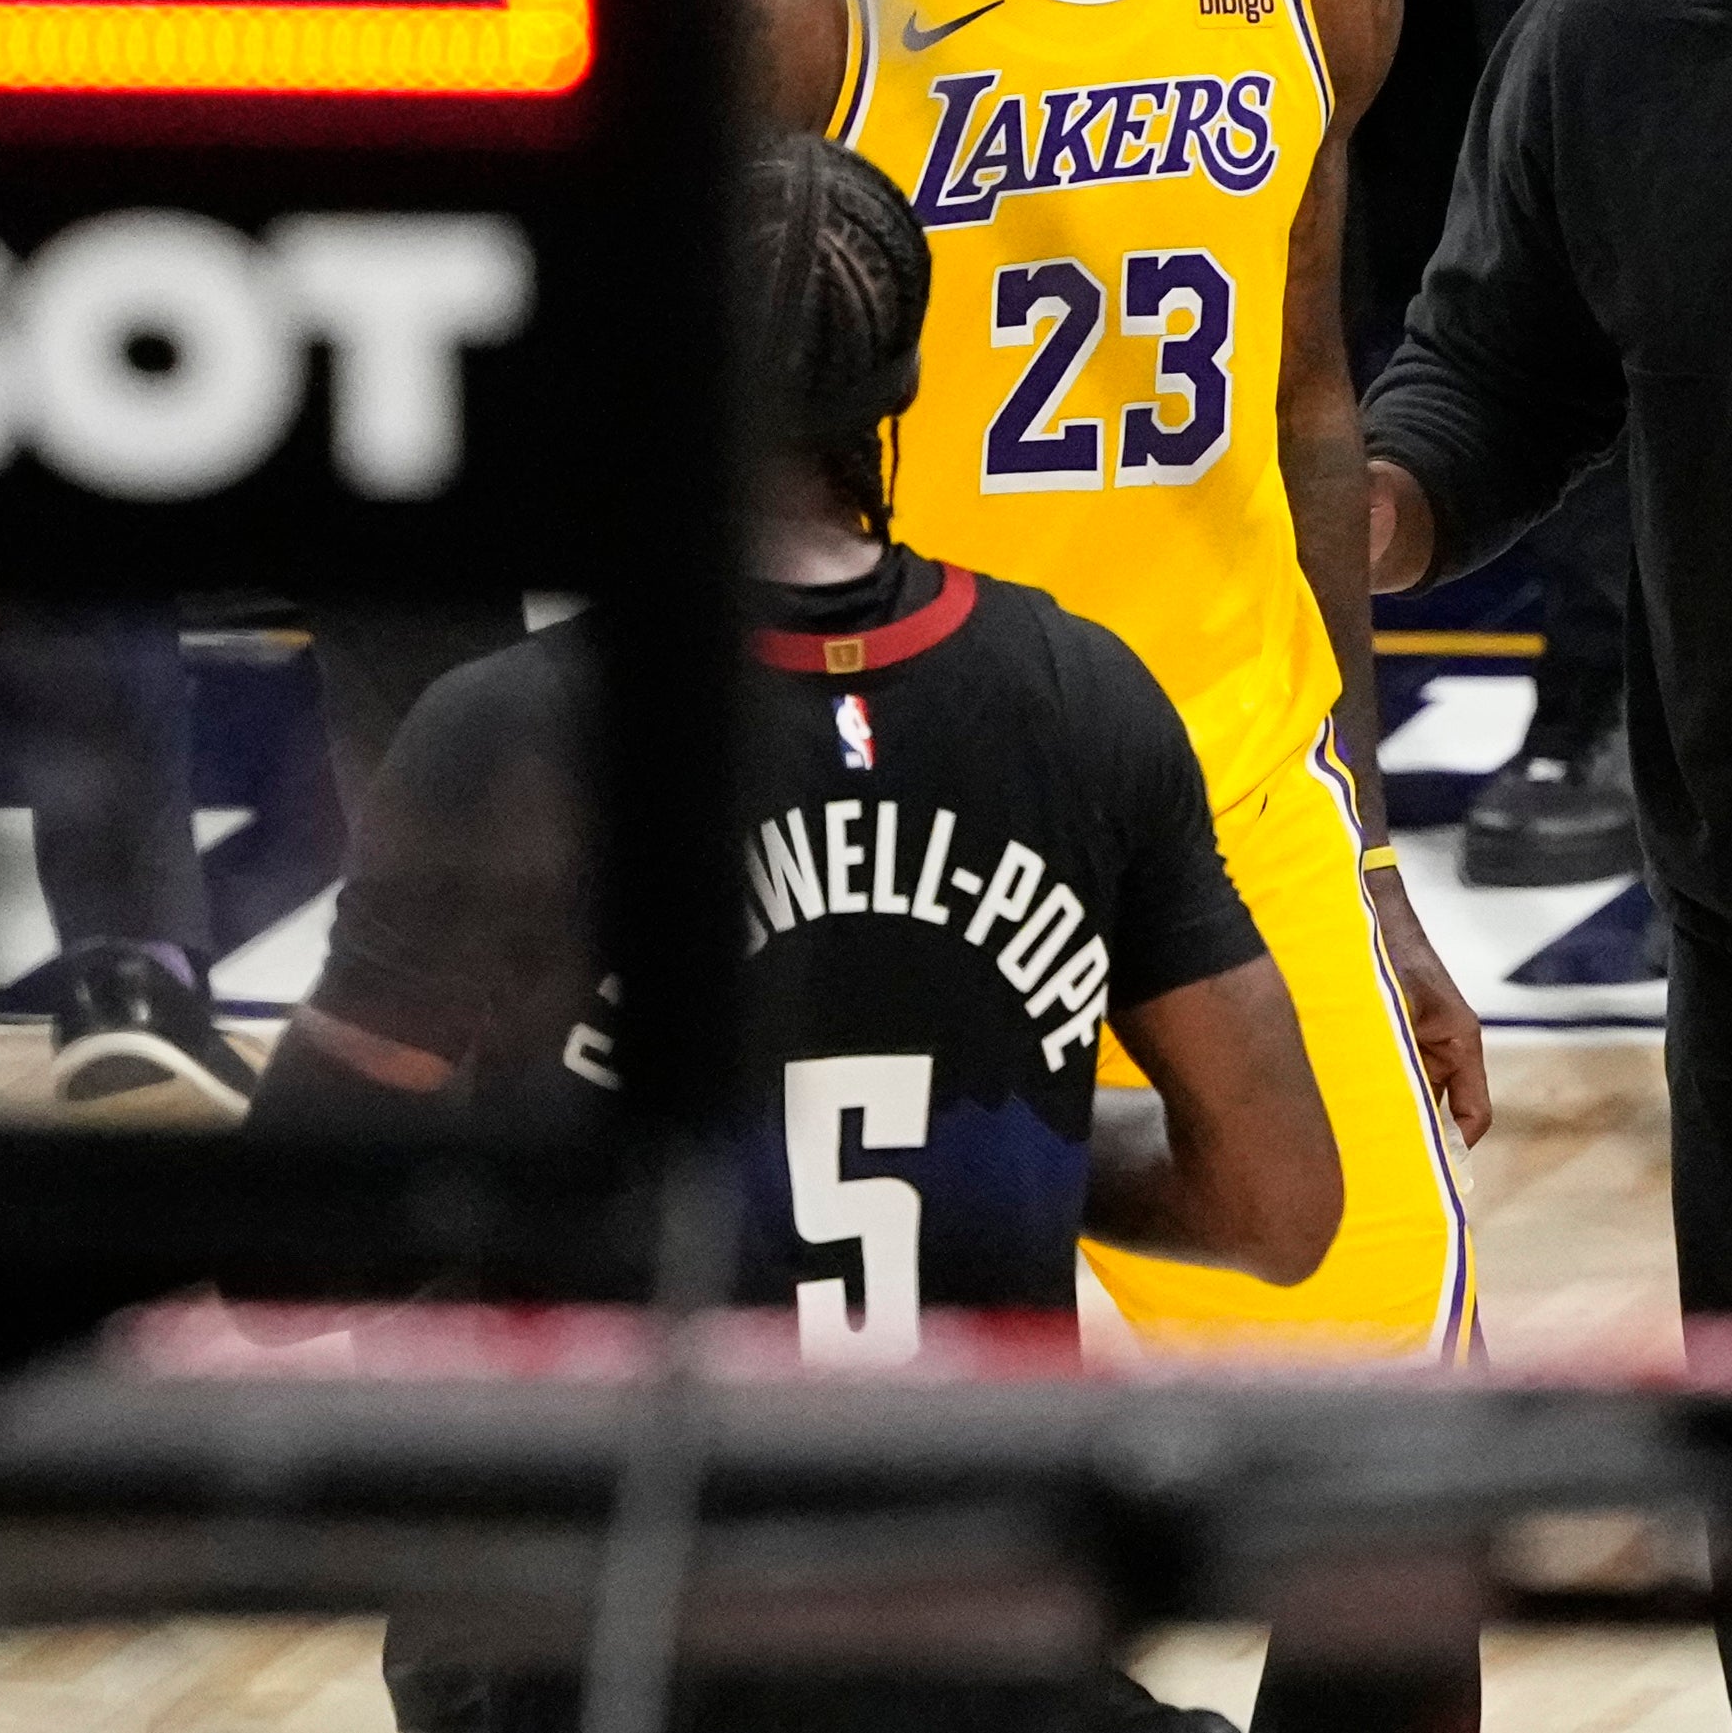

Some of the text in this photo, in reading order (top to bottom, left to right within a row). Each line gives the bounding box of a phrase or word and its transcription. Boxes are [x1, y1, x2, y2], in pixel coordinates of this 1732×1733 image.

[909, 69, 1279, 231] LAKERS
[979, 248, 1237, 496] 23
[784, 1054, 934, 1369] 5
